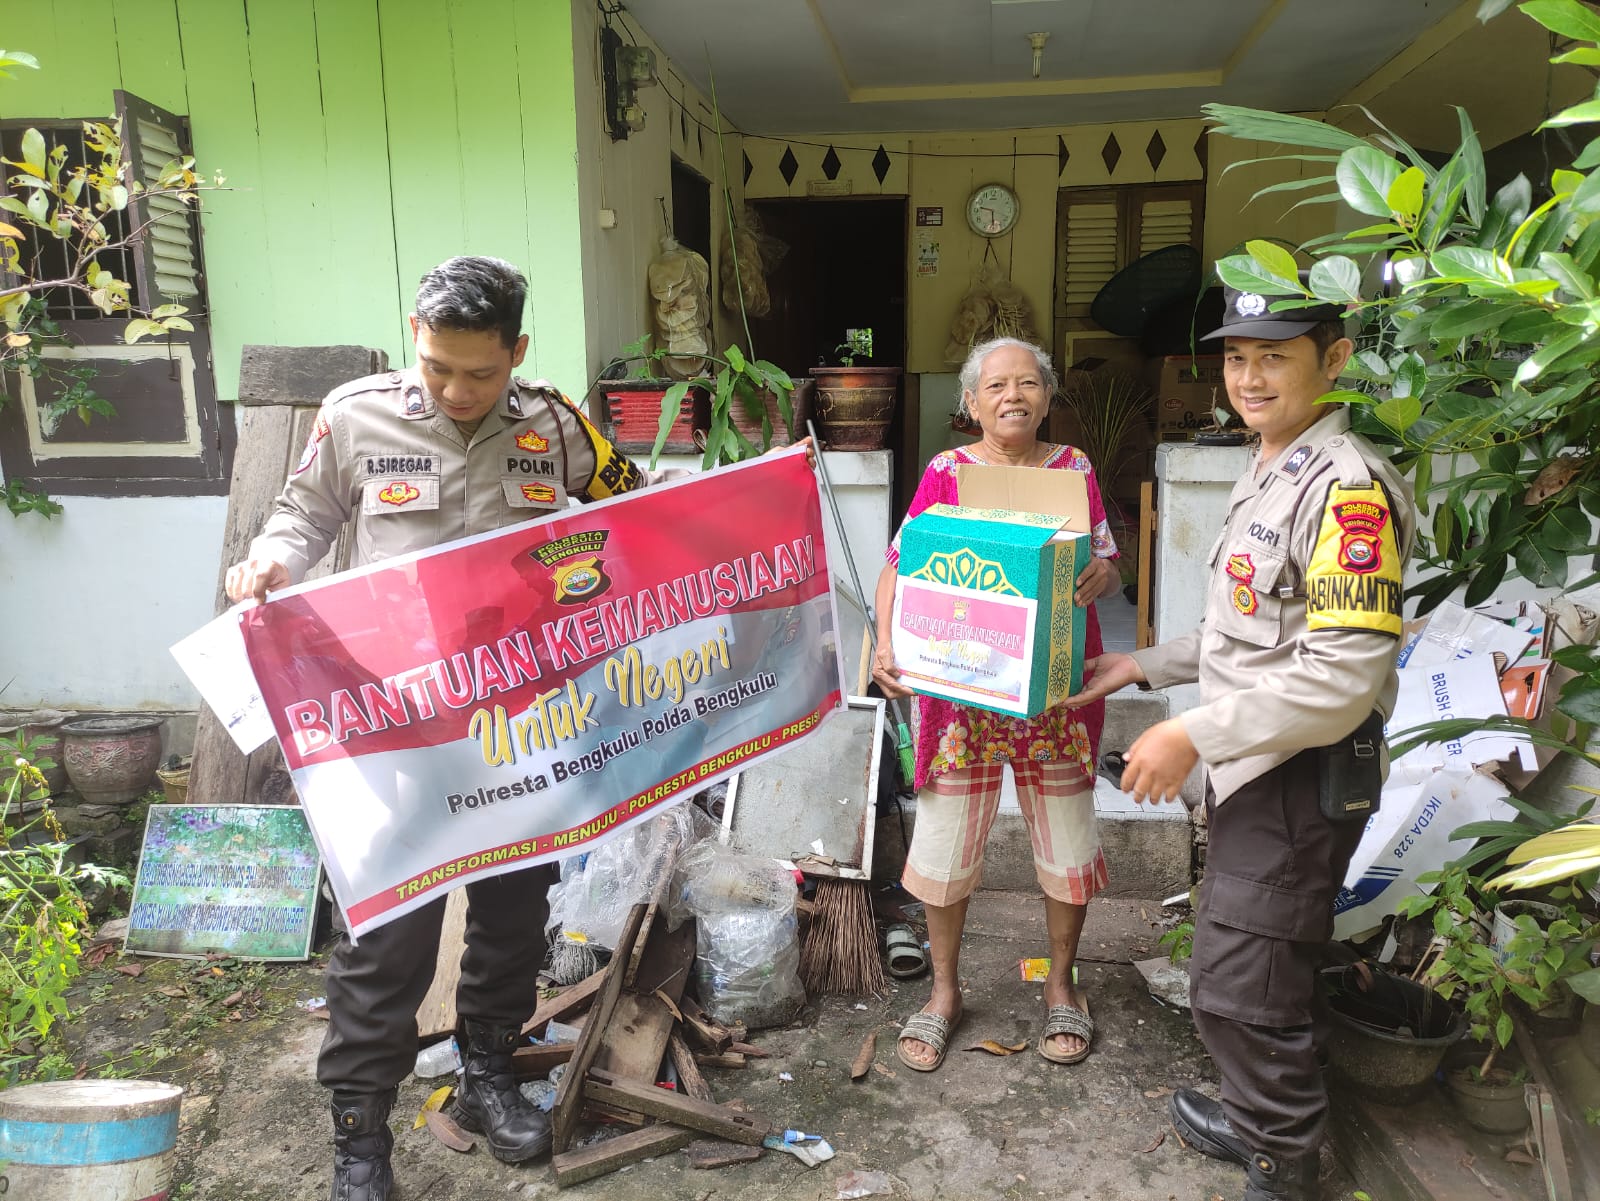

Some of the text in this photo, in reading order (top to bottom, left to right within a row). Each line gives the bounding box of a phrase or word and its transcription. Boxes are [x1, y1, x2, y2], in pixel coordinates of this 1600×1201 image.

[366, 456, 433, 475] R.SIREGAR
[506, 457, 555, 476] POLRI
[544, 543, 602, 566] BENGKULU
[284, 534, 816, 757] BANTUAN KEMANUSIAAN
[468, 626, 731, 767] Untuk Negeri
[1432, 672, 1452, 711] BRUSH
[446, 672, 778, 815] Polresta Bengkulu Polda Bengkulu
[395, 841, 538, 901] TRANSFORMASI
[553, 809, 618, 848] MENUJU
[628, 772, 697, 814] POLRESTA
[699, 735, 772, 778] BENGKULU
[782, 711, 820, 740] PRESISI
[1393, 795, 1442, 859] IKEDA 328
